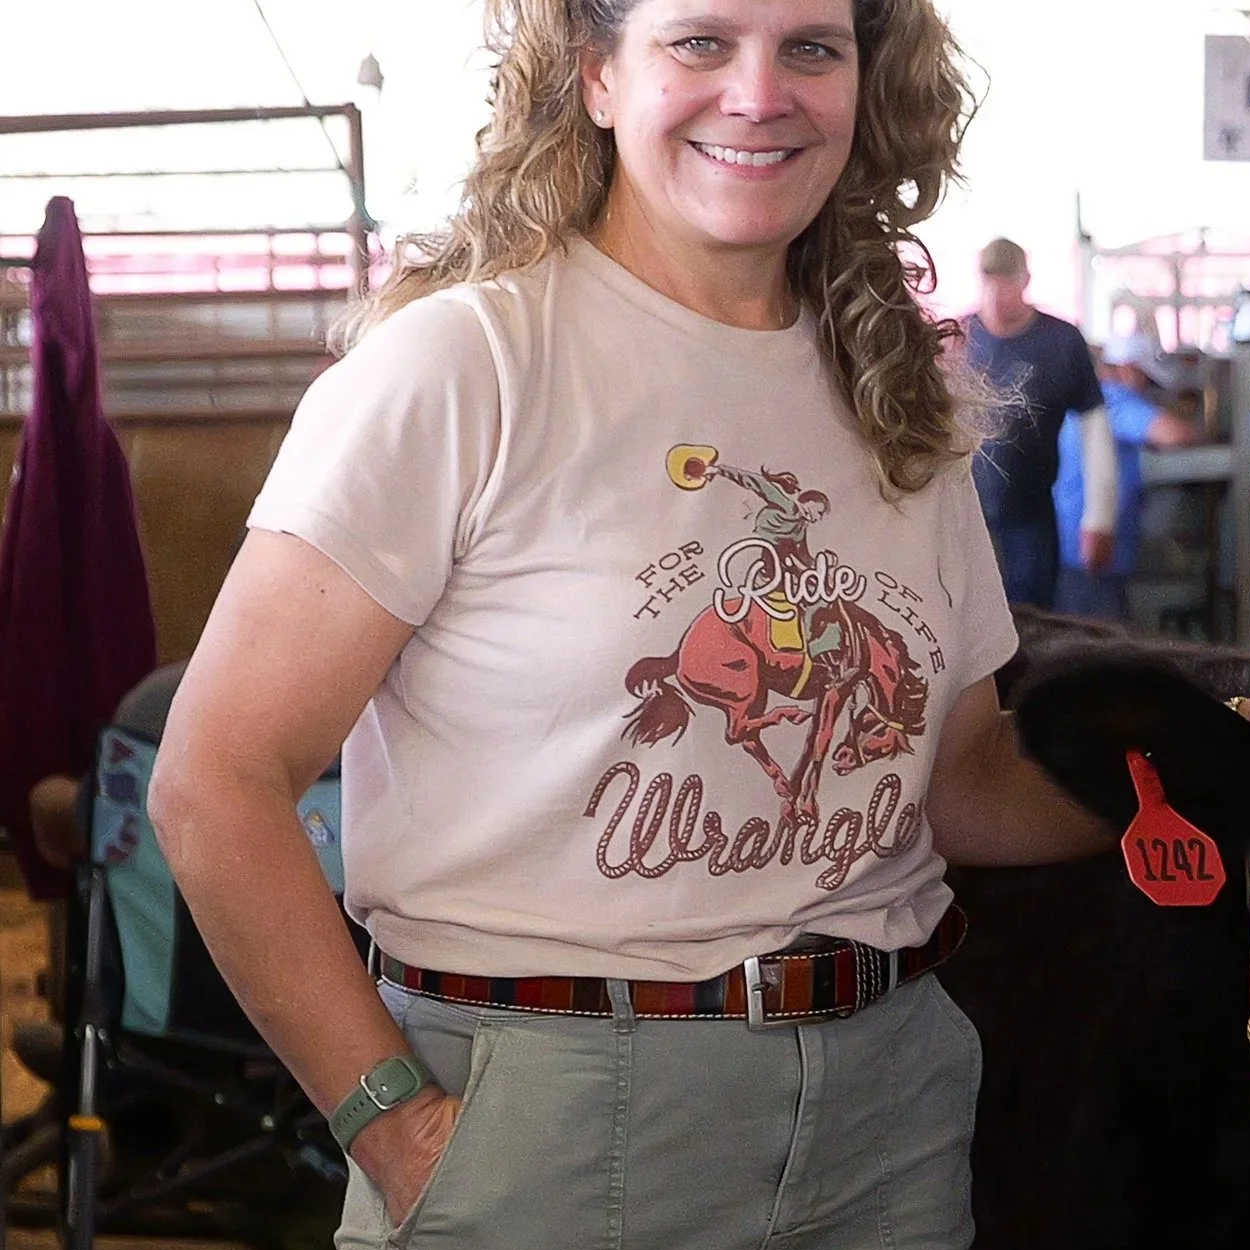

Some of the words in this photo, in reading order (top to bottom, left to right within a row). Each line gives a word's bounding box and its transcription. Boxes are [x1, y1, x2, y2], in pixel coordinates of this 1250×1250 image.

[633, 563, 706, 620] THE
[635, 540, 704, 589] FOR
[712, 537, 867, 624] Ride
[874, 571, 924, 603] OF
[876, 589, 946, 674] LIFE
[582, 761, 921, 891] Wrangle
[1135, 837, 1215, 882] 1242
